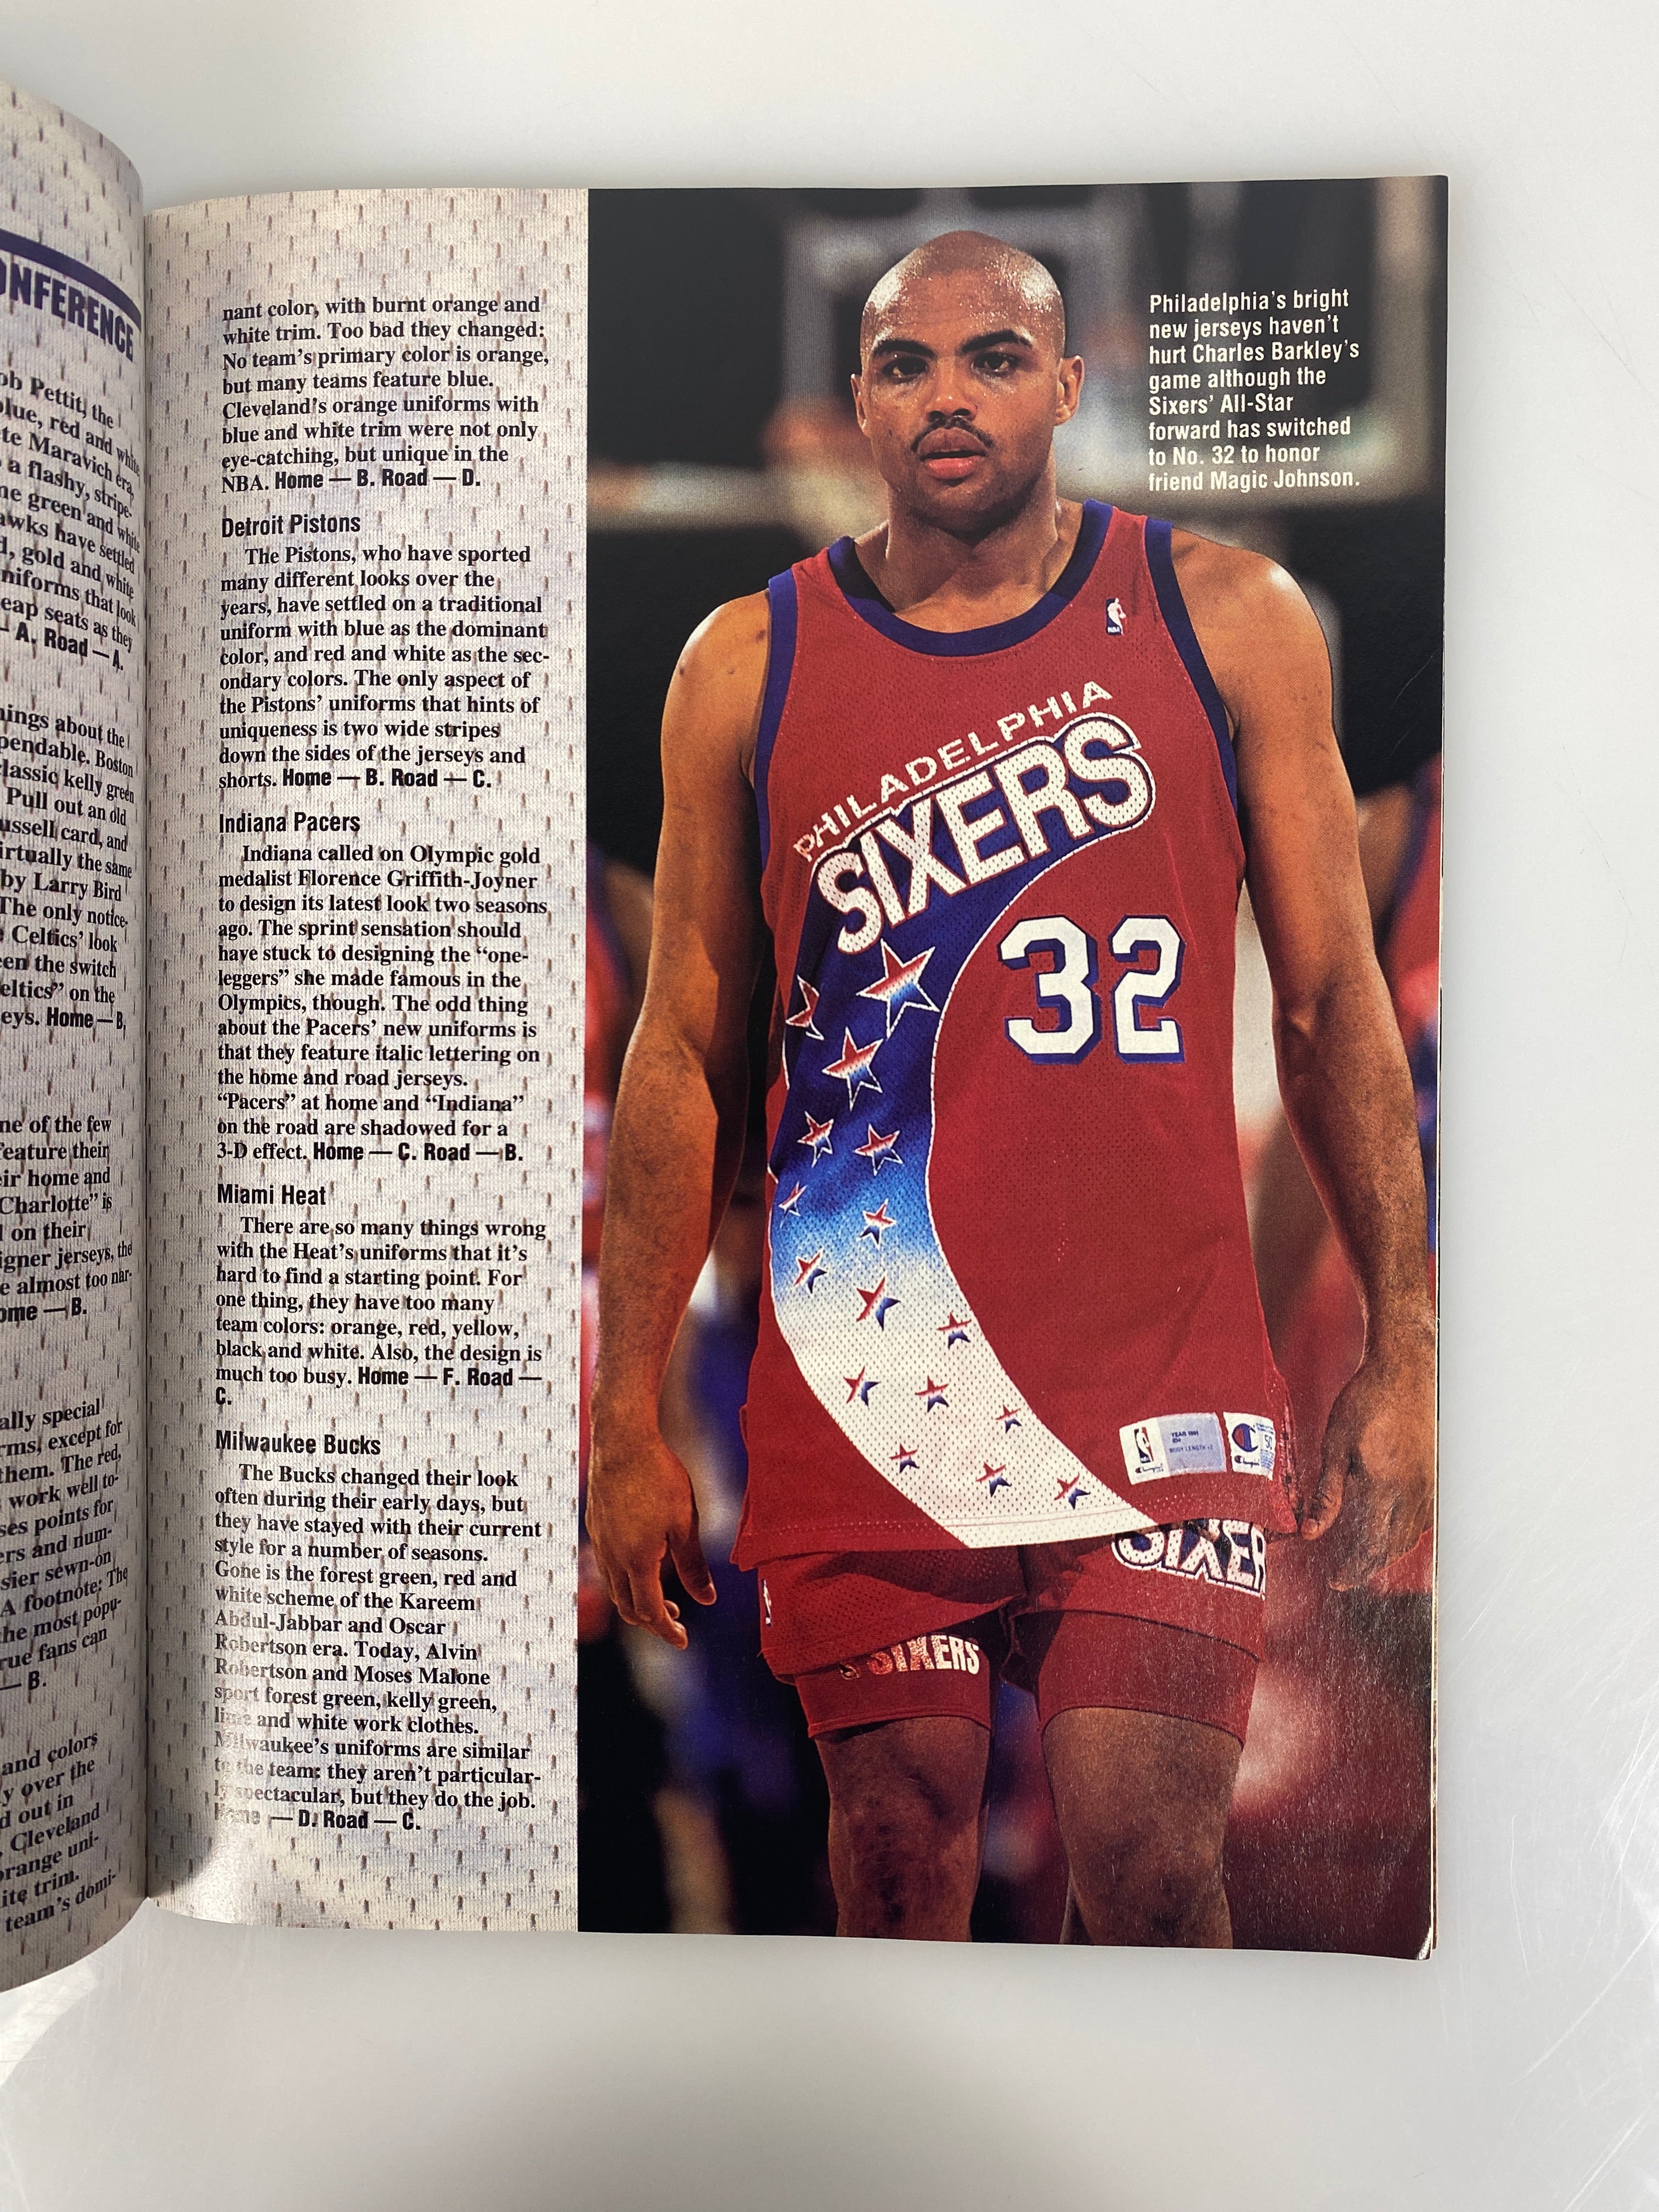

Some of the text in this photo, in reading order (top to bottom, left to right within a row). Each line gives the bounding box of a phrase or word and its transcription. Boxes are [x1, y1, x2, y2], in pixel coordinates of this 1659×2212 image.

[222, 296, 540, 321] nant color, with burnt orange and
[1150, 289, 1348, 315] Philadelphia's bright
[223, 320, 544, 345] white trim. Too bad they changed:
[1149, 314, 1339, 342] new jerseys haven't
[1149, 340, 1359, 364] hurt Charles Barkley's
[222, 370, 493, 394] but many teams feature blue.
[1149, 366, 1326, 394] game although the
[30, 376, 114, 428] Pettit, the
[1149, 393, 1294, 415] Sixers' All-Star
[1148, 416, 1351, 441] forward has switched
[1148, 444, 1321, 466] to No. 32 to honor
[8, 460, 133, 518] a flashy, stripe-
[1148, 469, 1359, 493] friend Magic Johnson.
[222, 514, 360, 538] Detroit Pistons
[245, 544, 531, 566] The Pistons, who have sported
[22, 546, 134, 599] gold and white
[219, 719, 500, 743] uniqueness is two wide stripes
[792, 680, 1113, 861] PHILADELPHIA
[5, 787, 127, 826] Pull out an old
[219, 811, 360, 834] Indiana Pacers
[813, 713, 1154, 956] SIXERS
[1, 869, 122, 902] by Larry Bird
[218, 869, 538, 893] medalist Florence Griffith-Joyner
[218, 919, 521, 941] ago. The sprint sensation should
[997, 914, 1187, 1064] 32
[218, 994, 528, 1017] Olympics, though. The odd thing
[217, 1183, 326, 1205] Miami Heat
[11, 1221, 86, 1242] on their
[216, 1265, 522, 1290] hard to find a starting point. For
[216, 1291, 493, 1315] one thing, they have too many
[216, 1317, 519, 1340] team colors: orange, red, yellow,
[216, 1429, 381, 1455] Milwaukee Bucks
[239, 1464, 518, 1489] The Bucks changed their look
[215, 1511, 542, 1537] they have stayed with their current
[215, 1537, 488, 1561] style for a number of seasons.
[1, 1565, 128, 1617] A footnote: The
[215, 1609, 446, 1635] Abdul-Jabbar and Oscar
[866, 1634, 980, 1675] SIXERS
[313, 1665, 348, 1681] and
[353, 1665, 412, 1684] Moses
[418, 1667, 490, 1685] Malone
[2, 1732, 99, 1776] and colors
[10, 1802, 100, 1852] Cleveland
